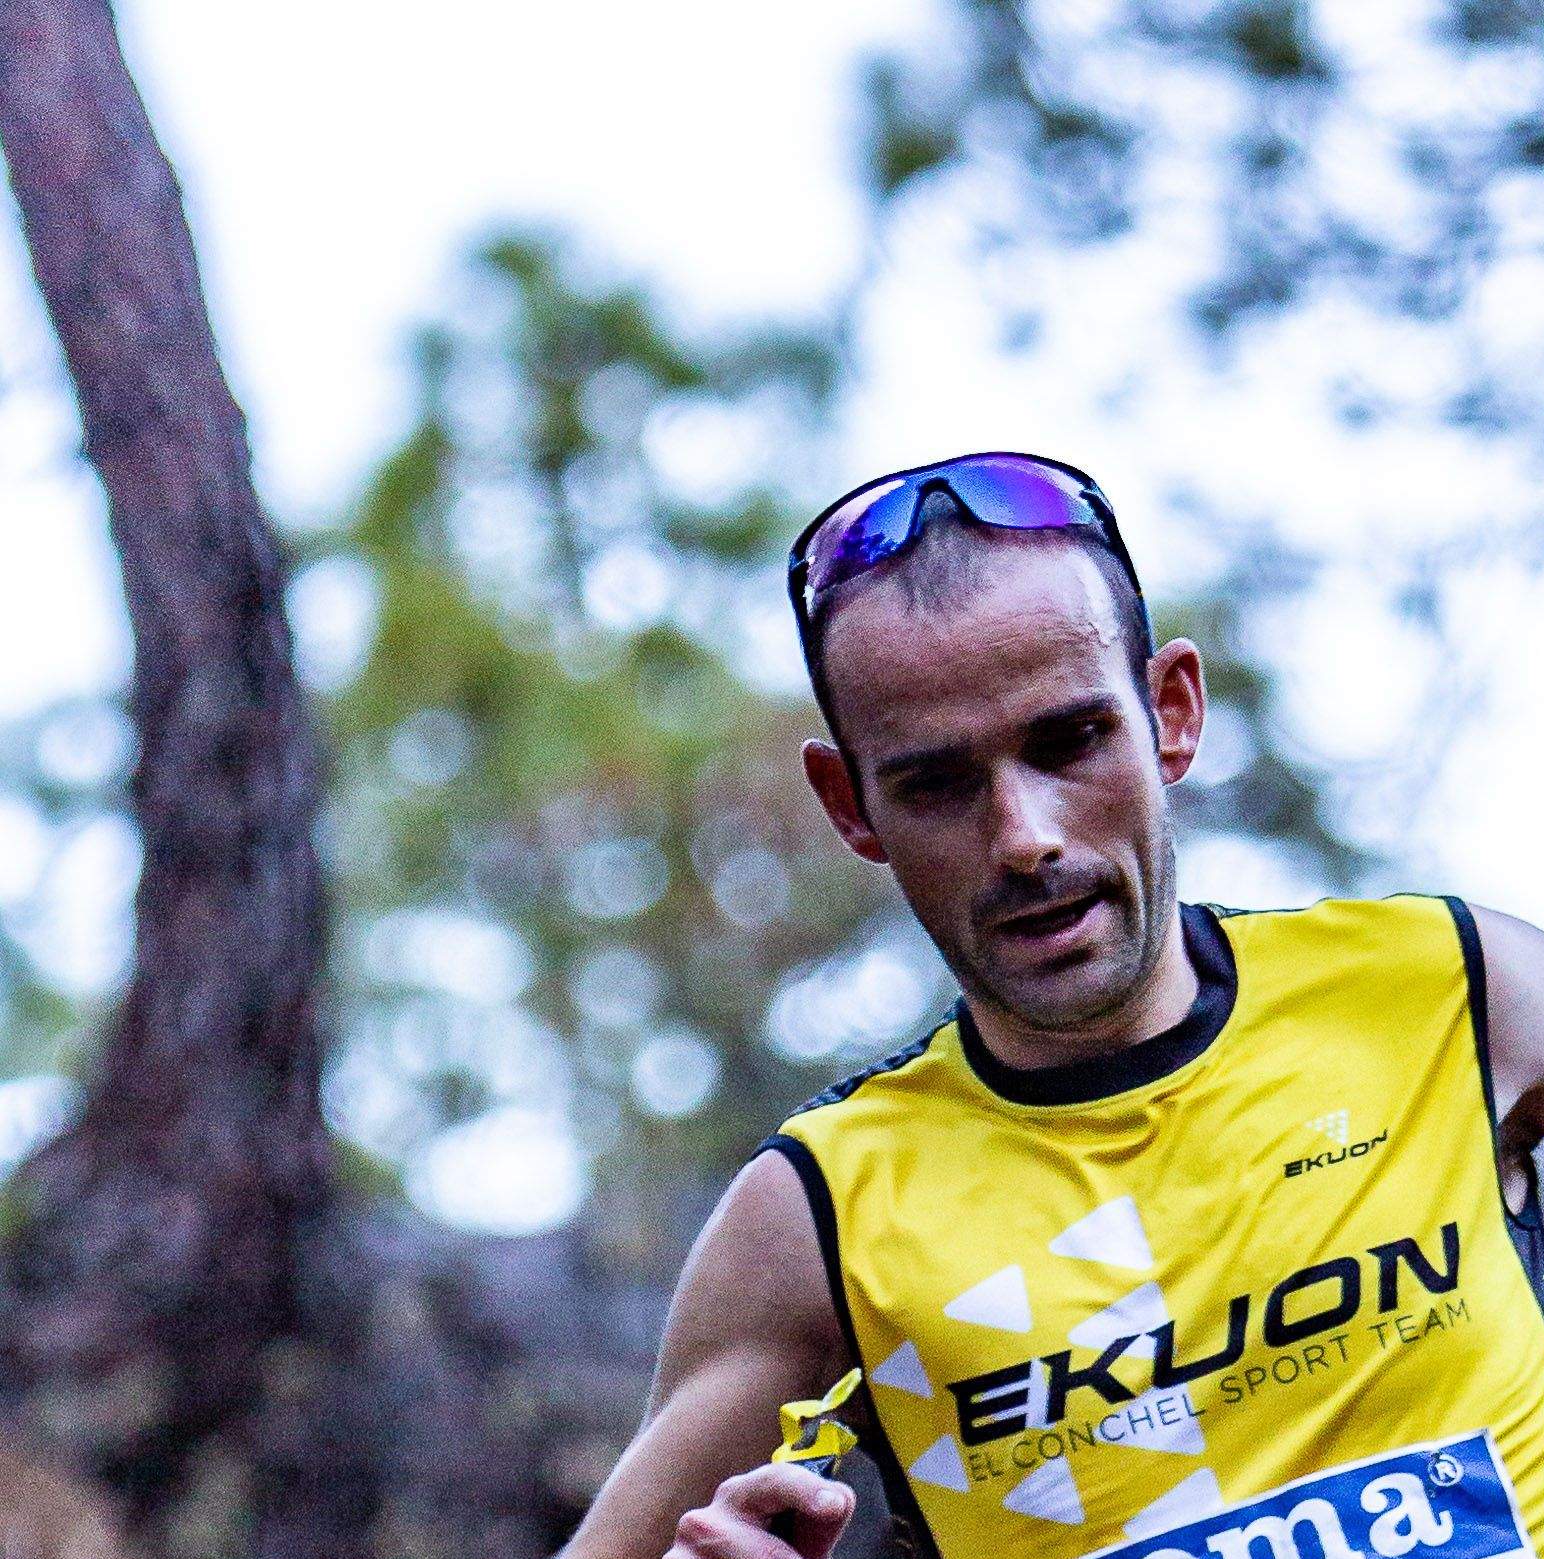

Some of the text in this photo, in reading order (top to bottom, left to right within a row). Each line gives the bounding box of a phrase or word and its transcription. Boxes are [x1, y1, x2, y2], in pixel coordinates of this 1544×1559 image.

[1284, 1127, 1389, 1178] EKUON
[945, 1222, 1461, 1447] EKUON
[967, 1298, 1473, 1482] EL CONCHEL SPORT TEAM
